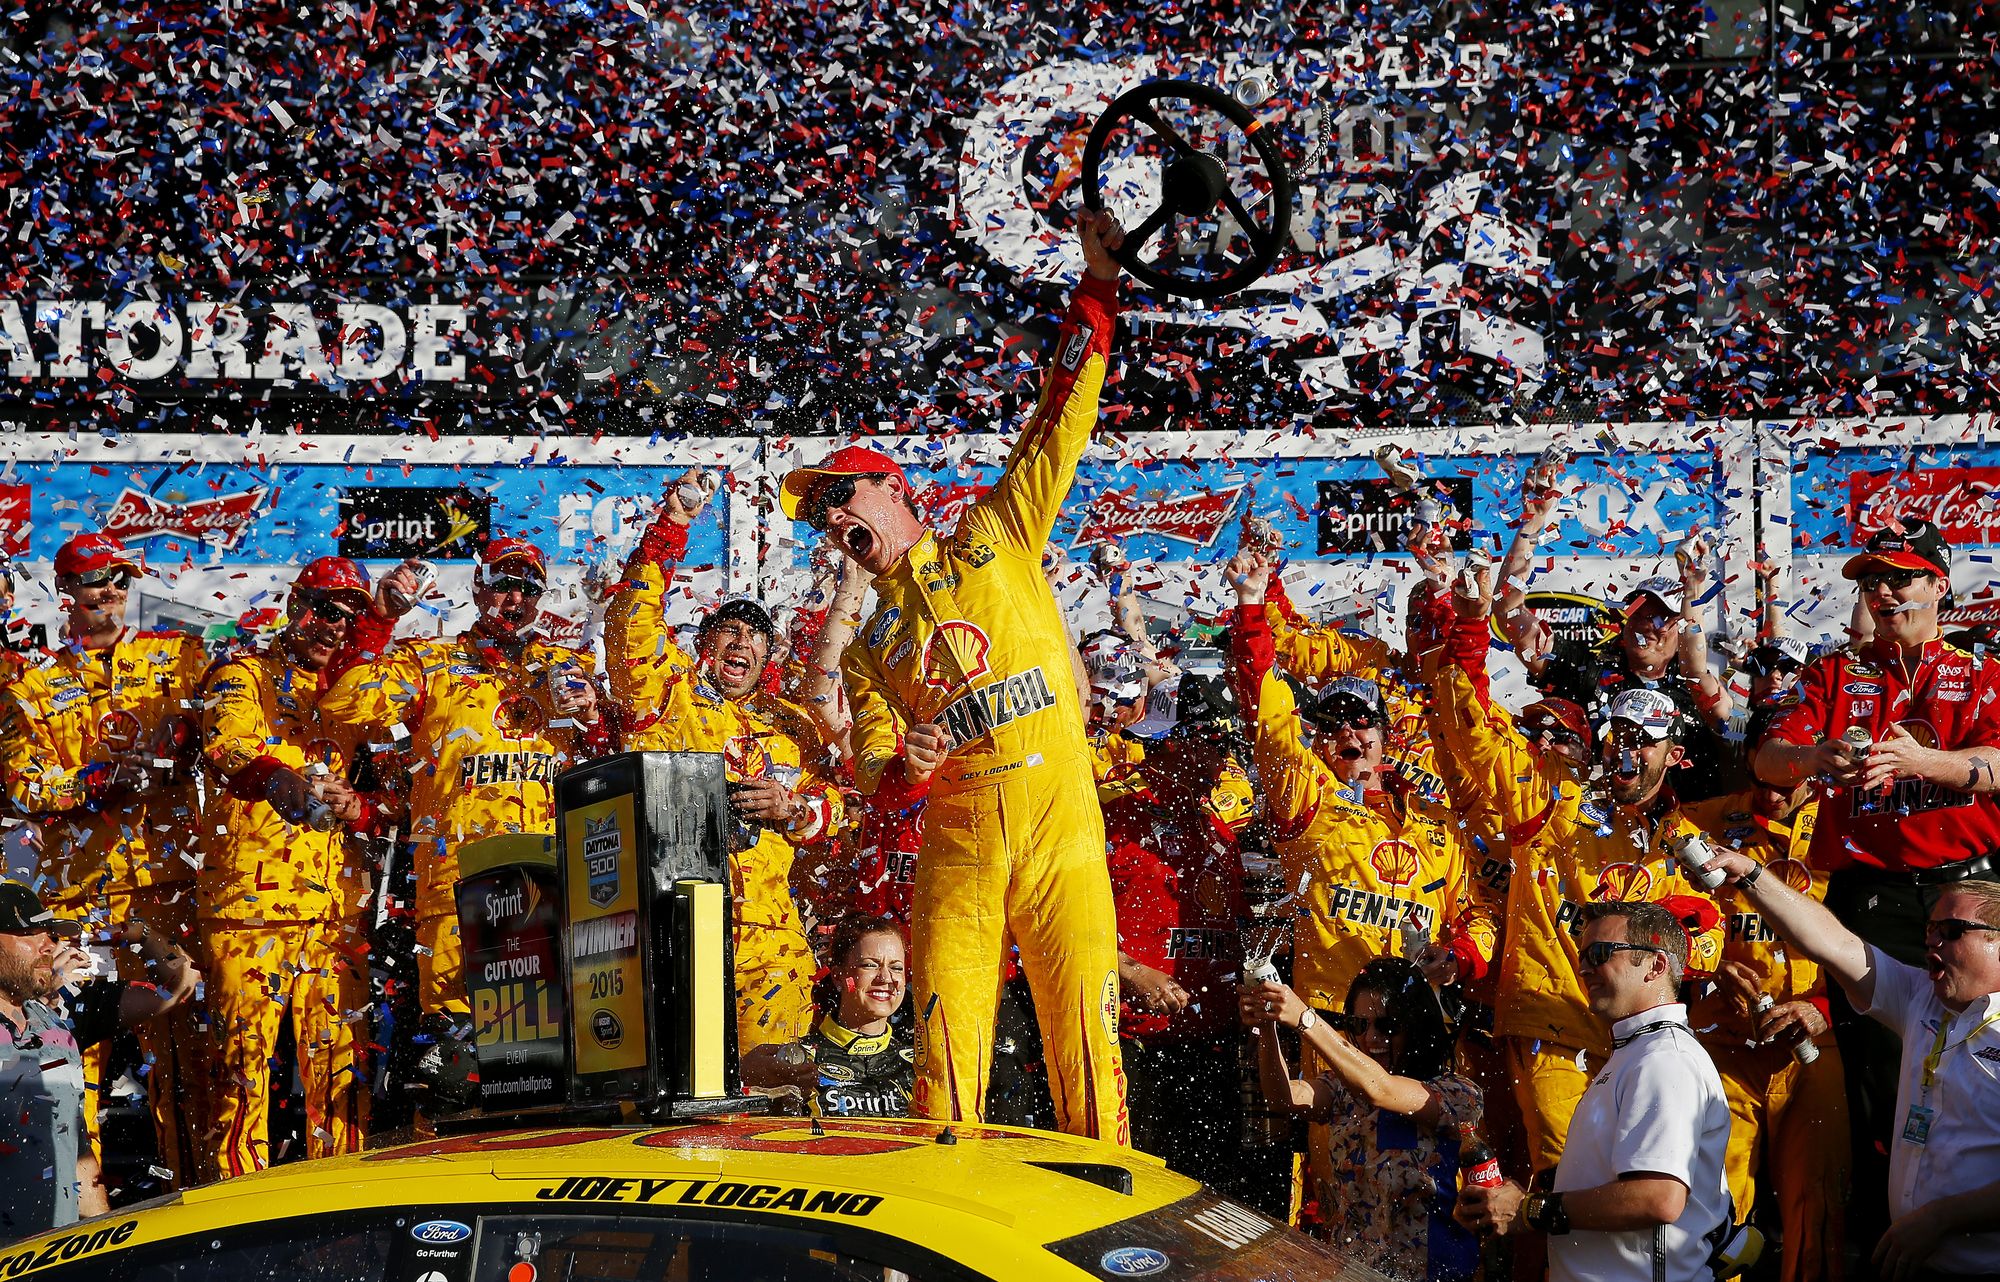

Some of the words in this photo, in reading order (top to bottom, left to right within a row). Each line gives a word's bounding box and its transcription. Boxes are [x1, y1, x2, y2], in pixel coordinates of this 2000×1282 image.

[351, 513, 436, 540] Sprint
[968, 544, 993, 568] PPG
[1535, 606, 1586, 624] NASCAR
[874, 612, 894, 641] Ford
[58, 688, 82, 701] Ford
[700, 686, 723, 703] Ford
[1851, 684, 1876, 695] Ford
[958, 771, 981, 782] JOEY
[984, 761, 1023, 776] LOGANO
[586, 834, 619, 855] DAYTONA
[1427, 831, 1445, 847] PPG
[591, 856, 615, 876] 500
[485, 887, 523, 927] Sprint
[506, 937, 520, 952] THE
[573, 913, 637, 958] WINNER
[484, 960, 507, 982] CUT
[507, 954, 541, 978] YOUR
[589, 968, 624, 1001] 2015
[474, 979, 560, 1047] BILL
[506, 1049, 528, 1065] EVENT
[852, 1043, 876, 1056] Sprint
[481, 1075, 552, 1098] sprint.com/halfprice
[825, 1087, 901, 1117] Sprint
[1467, 1160, 1502, 1185] Coca-Cola
[536, 1177, 669, 1203] JOEY
[676, 1180, 885, 1217] LOGANO
[422, 1223, 460, 1240] Ford
[416, 1249, 428, 1258] Go
[429, 1249, 458, 1258] Further
[1114, 1252, 1160, 1272] Ford
